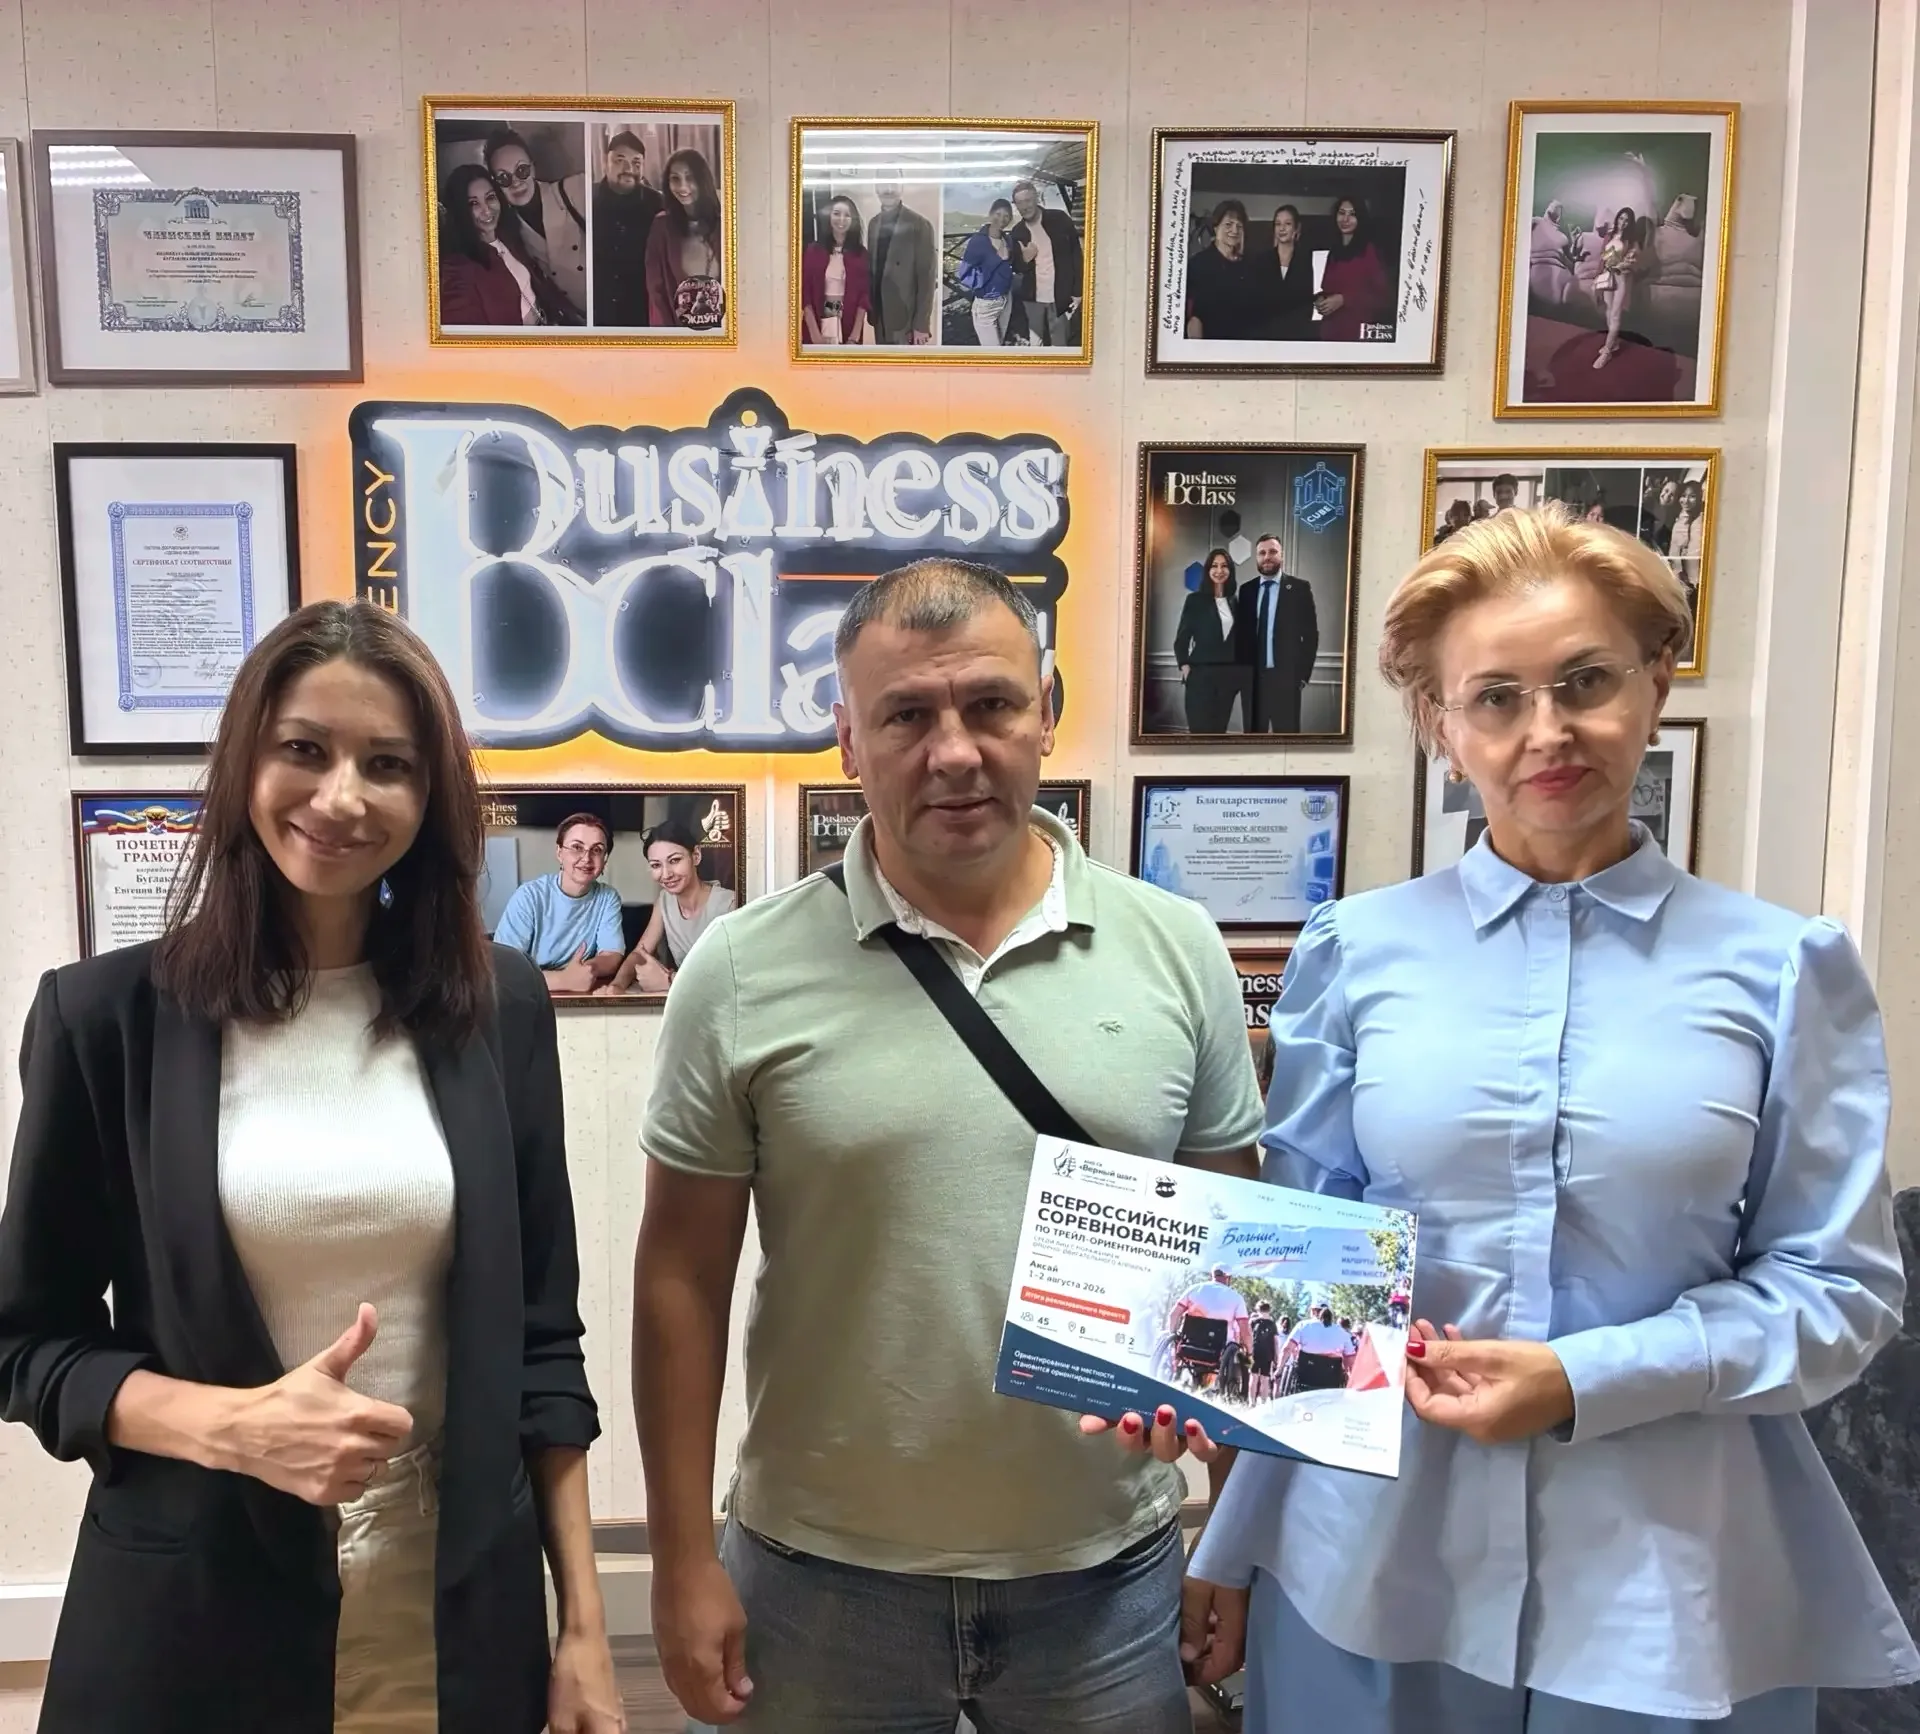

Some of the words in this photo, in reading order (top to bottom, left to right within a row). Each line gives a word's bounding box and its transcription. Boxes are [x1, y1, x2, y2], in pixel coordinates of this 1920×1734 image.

[1187, 485, 1236, 505] Class
[1305, 505, 1333, 524] CUBE
[1196, 796, 1288, 807] Благодарственное
[1040, 1191, 1209, 1240] ВСЕРОССИЙСКИЕ
[1038, 1208, 1201, 1255] СОРЕВНОВАНИЯ
[1217, 1227, 1280, 1250] Больше,
[1035, 1224, 1050, 1234] ПО
[1053, 1227, 1191, 1265] ТРЕЙЛ-ОРИЕНТИРОВАНИЮ
[1237, 1243, 1261, 1257] чем
[1264, 1240, 1312, 1262] спорт!
[1029, 1260, 1059, 1273] Аксай
[1046, 1275, 1081, 1290] августа
[1083, 1283, 1106, 1295] 2026
[1037, 1316, 1050, 1326] 45
[1128, 1337, 1135, 1345] 2
[1012, 1360, 1050, 1374] становится
[1050, 1370, 1111, 1389] ориентированием
[1014, 1350, 1071, 1369] Ориентирование
[1080, 1366, 1115, 1380] местности
